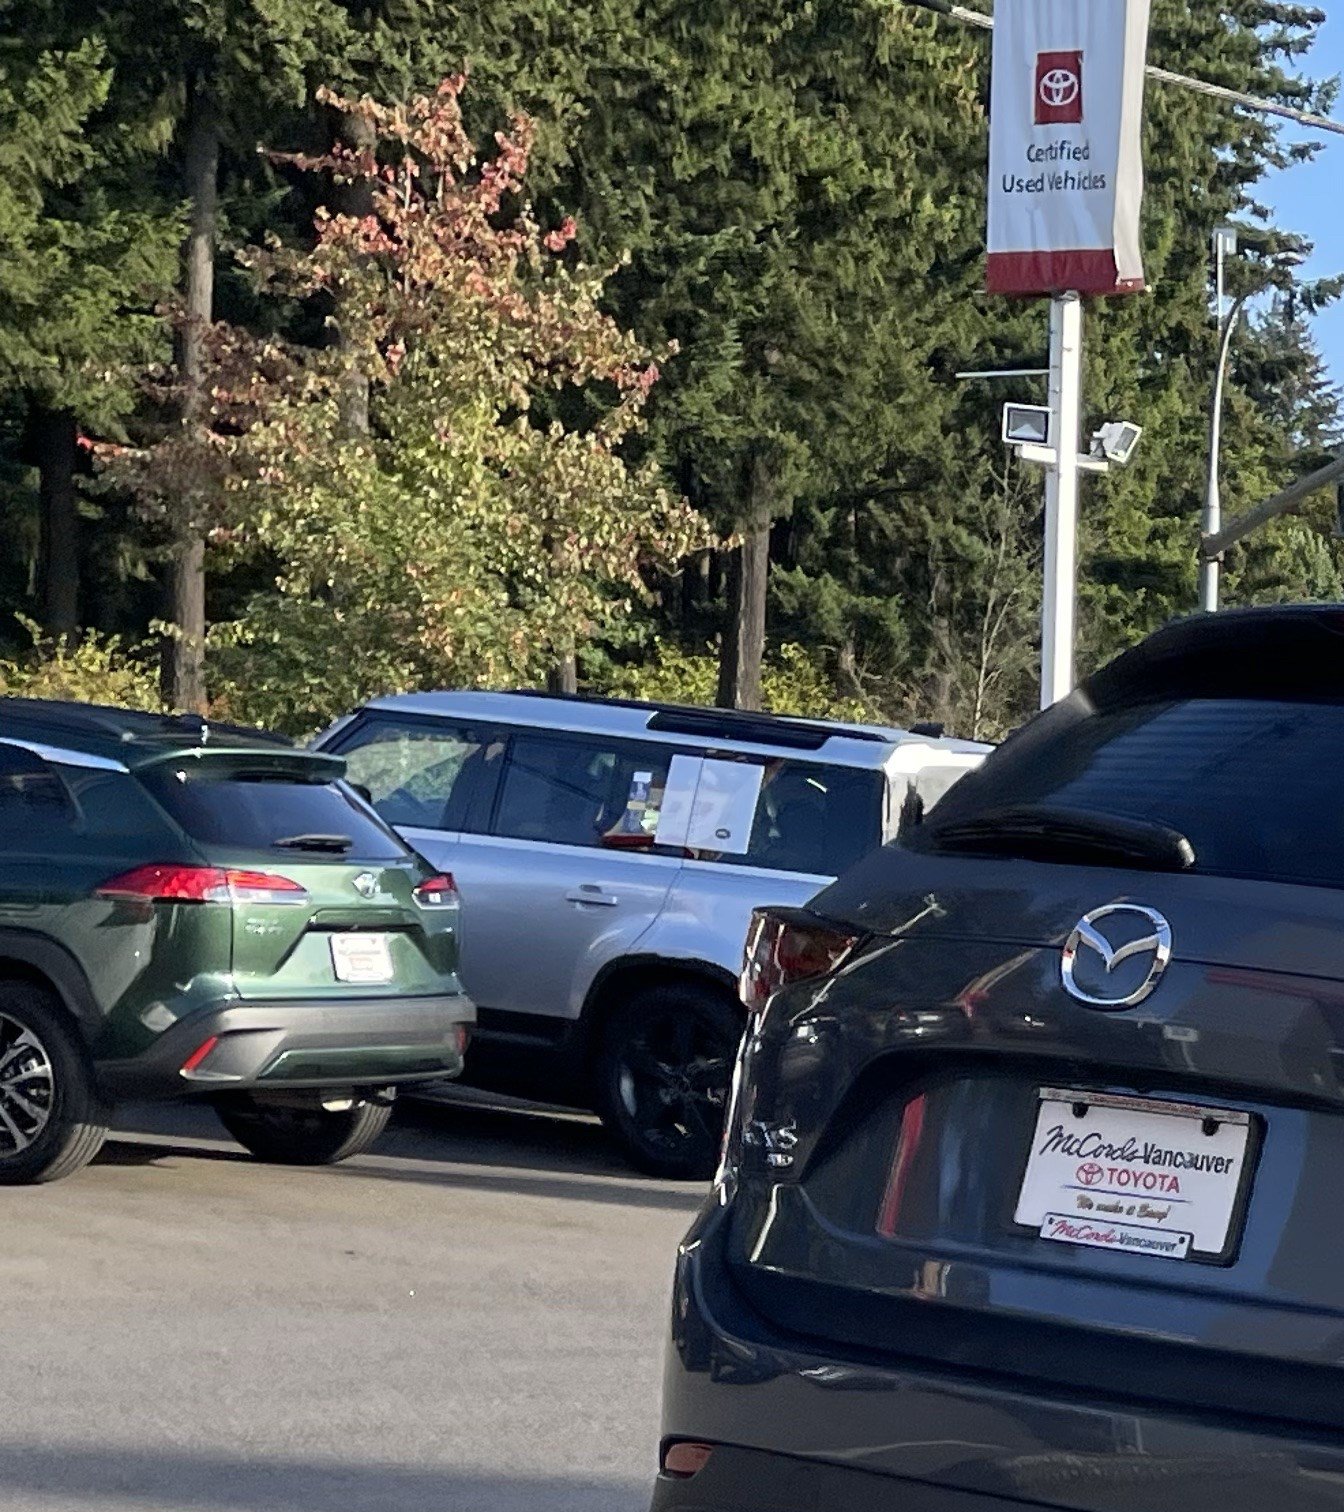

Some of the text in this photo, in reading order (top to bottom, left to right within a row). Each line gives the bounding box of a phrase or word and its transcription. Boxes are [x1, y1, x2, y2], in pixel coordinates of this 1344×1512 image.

[1027, 140, 1090, 162] Certified
[1002, 170, 1107, 193] Used Vehicles
[1143, 1142, 1235, 1175] Vancouver
[1107, 1167, 1180, 1194] TOYOTA
